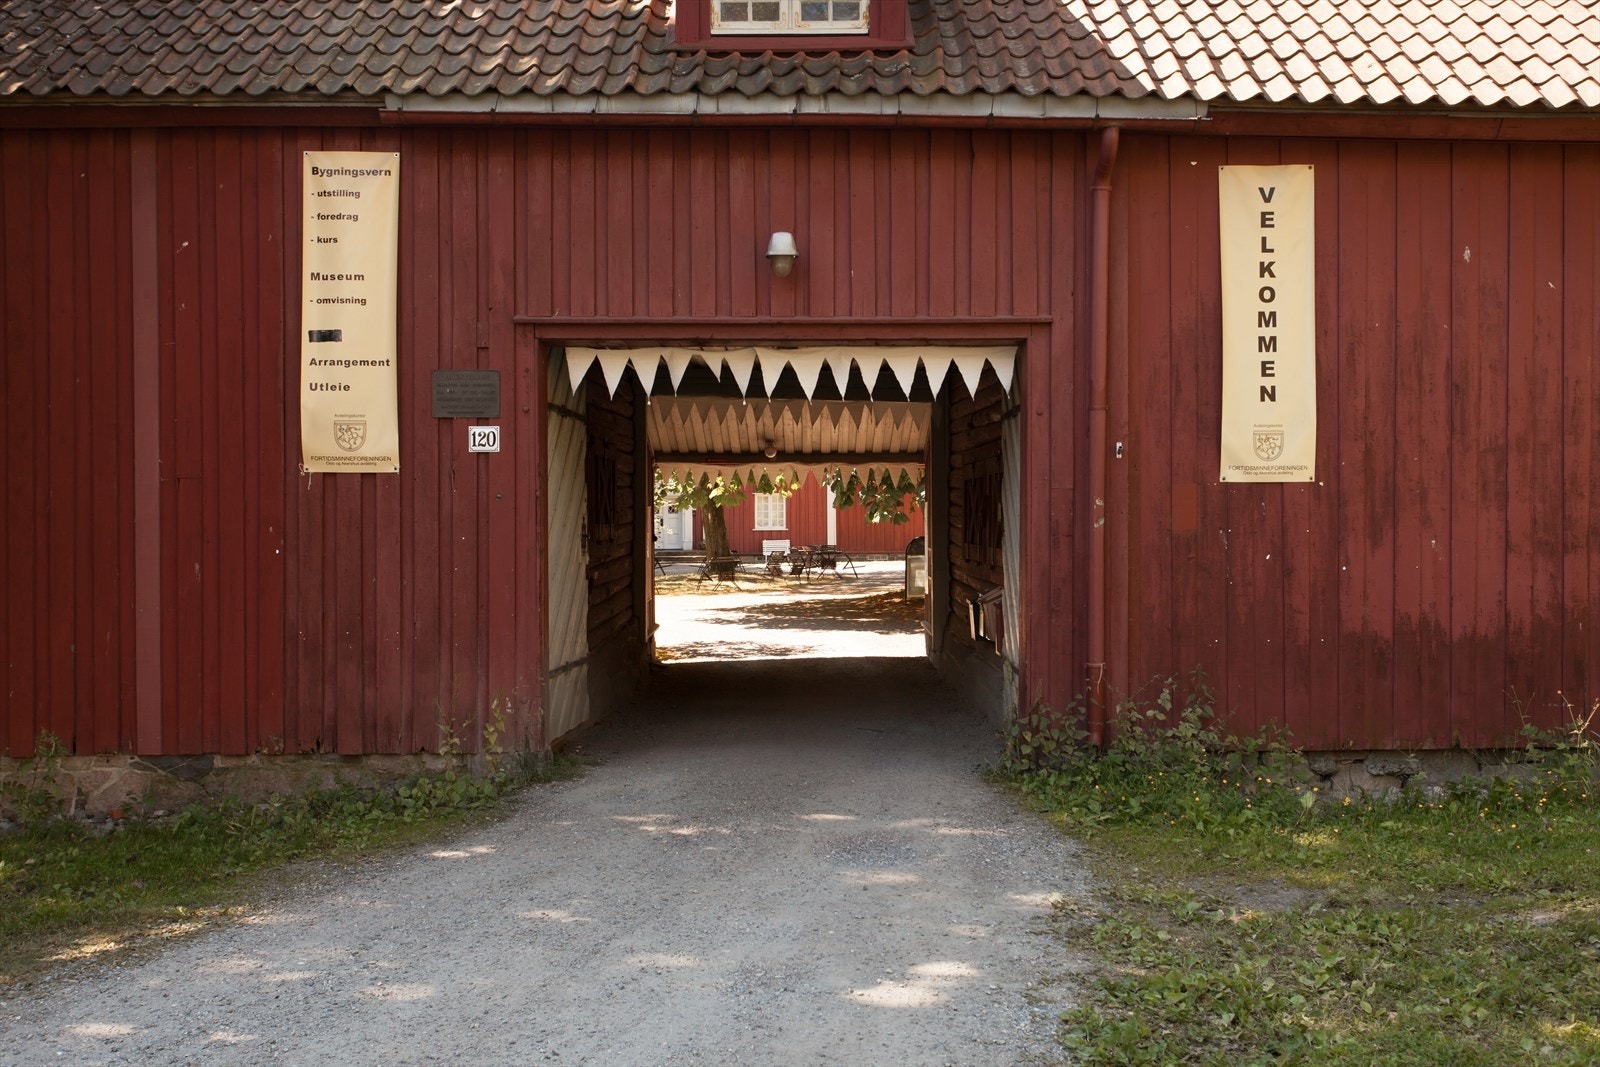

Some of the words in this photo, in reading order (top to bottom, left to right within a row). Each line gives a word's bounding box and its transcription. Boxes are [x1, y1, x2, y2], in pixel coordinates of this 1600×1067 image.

[312, 167, 391, 178] Bygningsvern
[317, 190, 360, 198] utstilling
[317, 213, 358, 222] foredrag
[310, 272, 364, 281] Museum
[1258, 186, 1278, 402] VELKOMMEN
[316, 297, 366, 306] omvisning
[309, 358, 390, 368] Arrangement
[310, 383, 350, 391] Utleie
[472, 431, 496, 447] 120
